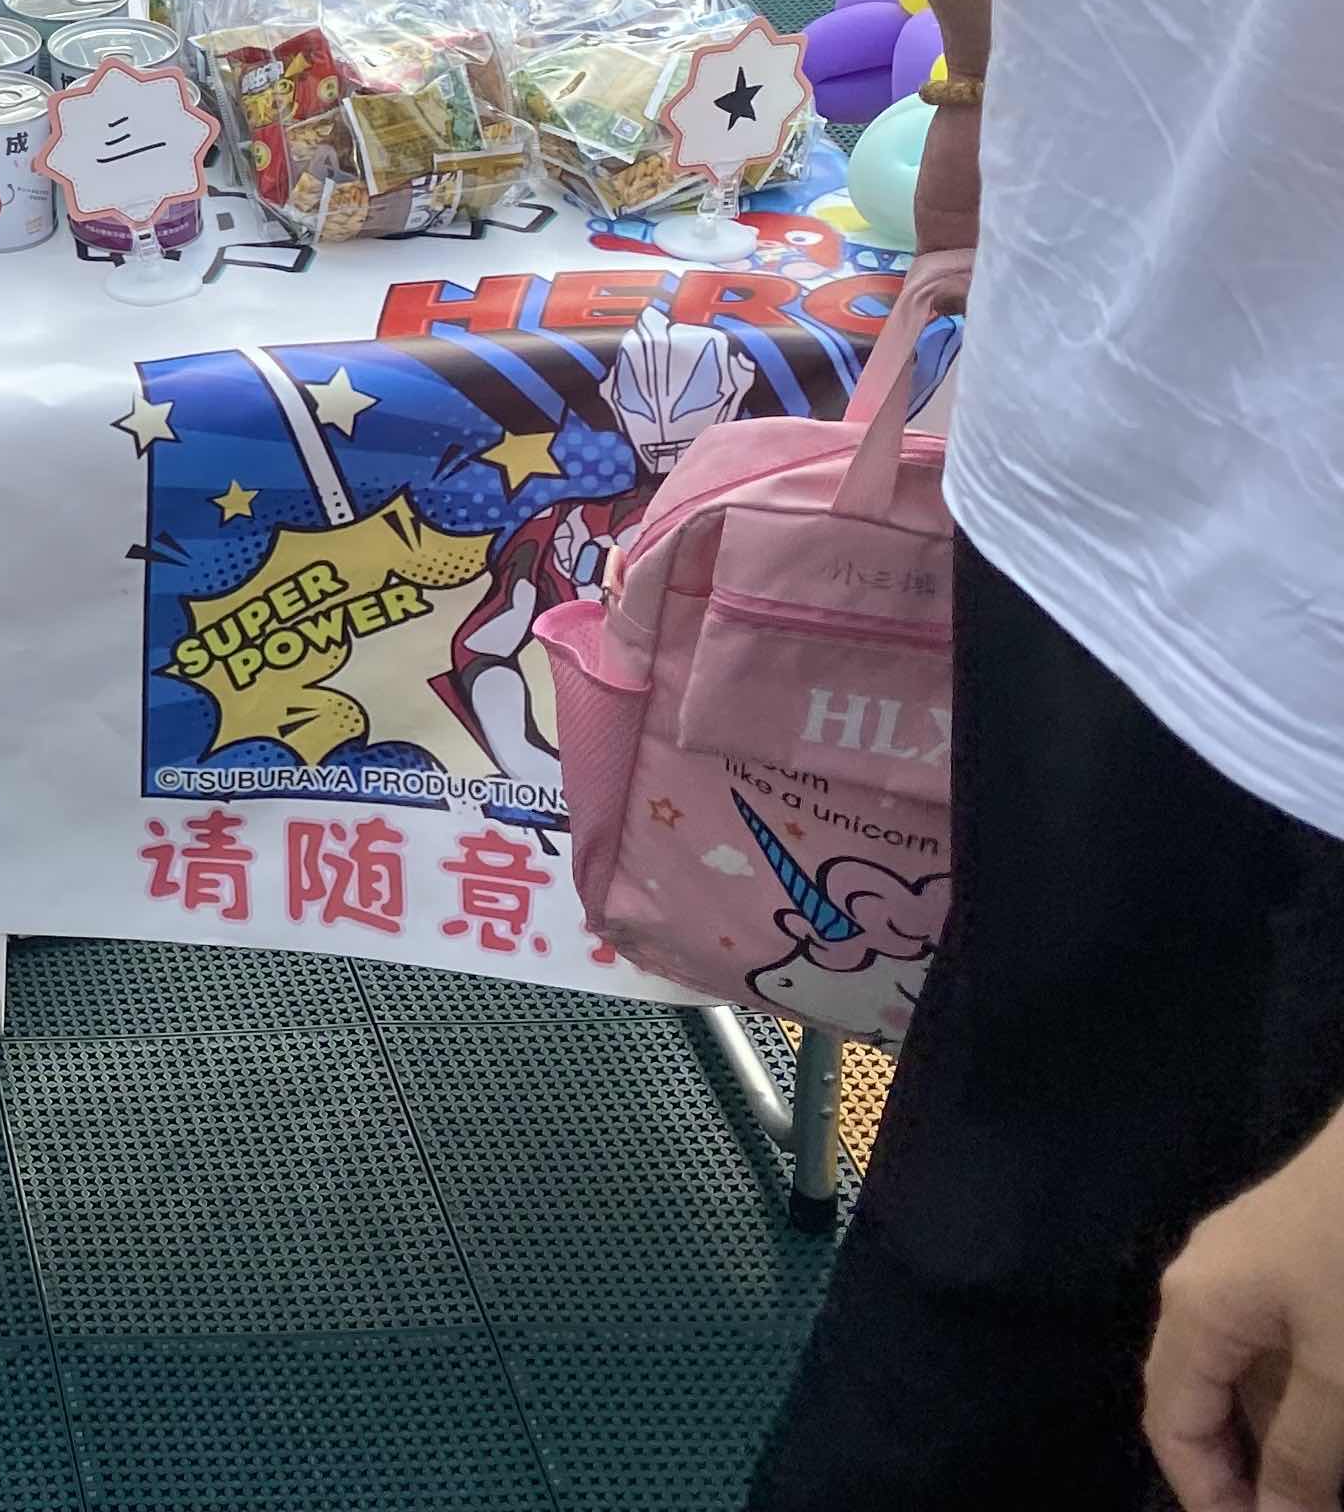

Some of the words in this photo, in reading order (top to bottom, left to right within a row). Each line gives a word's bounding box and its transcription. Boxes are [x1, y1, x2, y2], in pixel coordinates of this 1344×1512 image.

[96, 116, 167, 164] 三
[376, 269, 907, 339] HERO
[176, 559, 343, 677] SUPER
[230, 575, 430, 687] POWER
[724, 756, 773, 794] like
[781, 790, 802, 809] a
[813, 802, 940, 855] unicorn
[140, 810, 616, 966] 请随意
